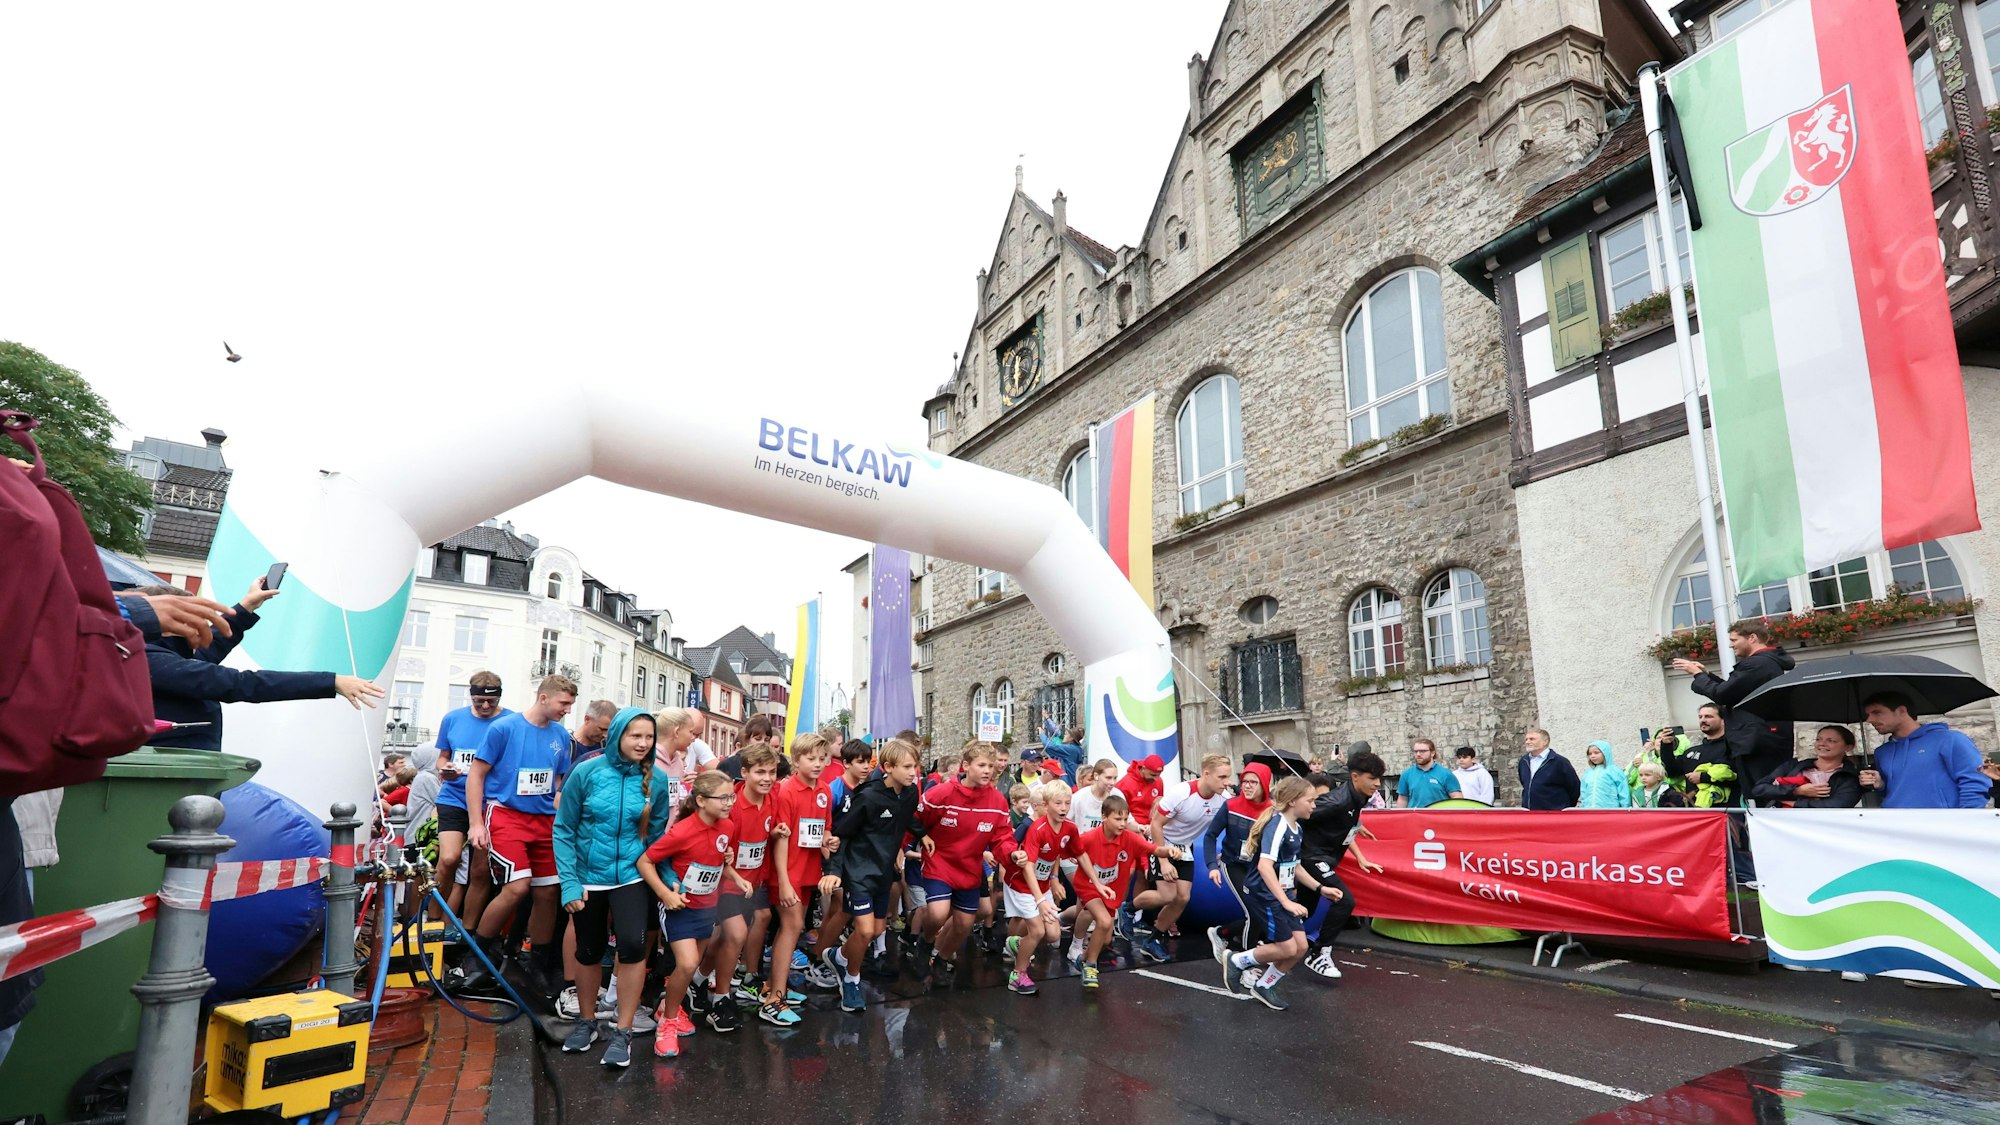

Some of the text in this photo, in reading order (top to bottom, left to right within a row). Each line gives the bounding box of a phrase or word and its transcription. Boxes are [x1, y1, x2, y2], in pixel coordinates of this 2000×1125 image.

[758, 417, 912, 488] BELKAW
[754, 455, 880, 501] Im Herzen bergisch.
[529, 772, 549, 784] 1467
[1459, 851, 1685, 887] Kreissparkasse
